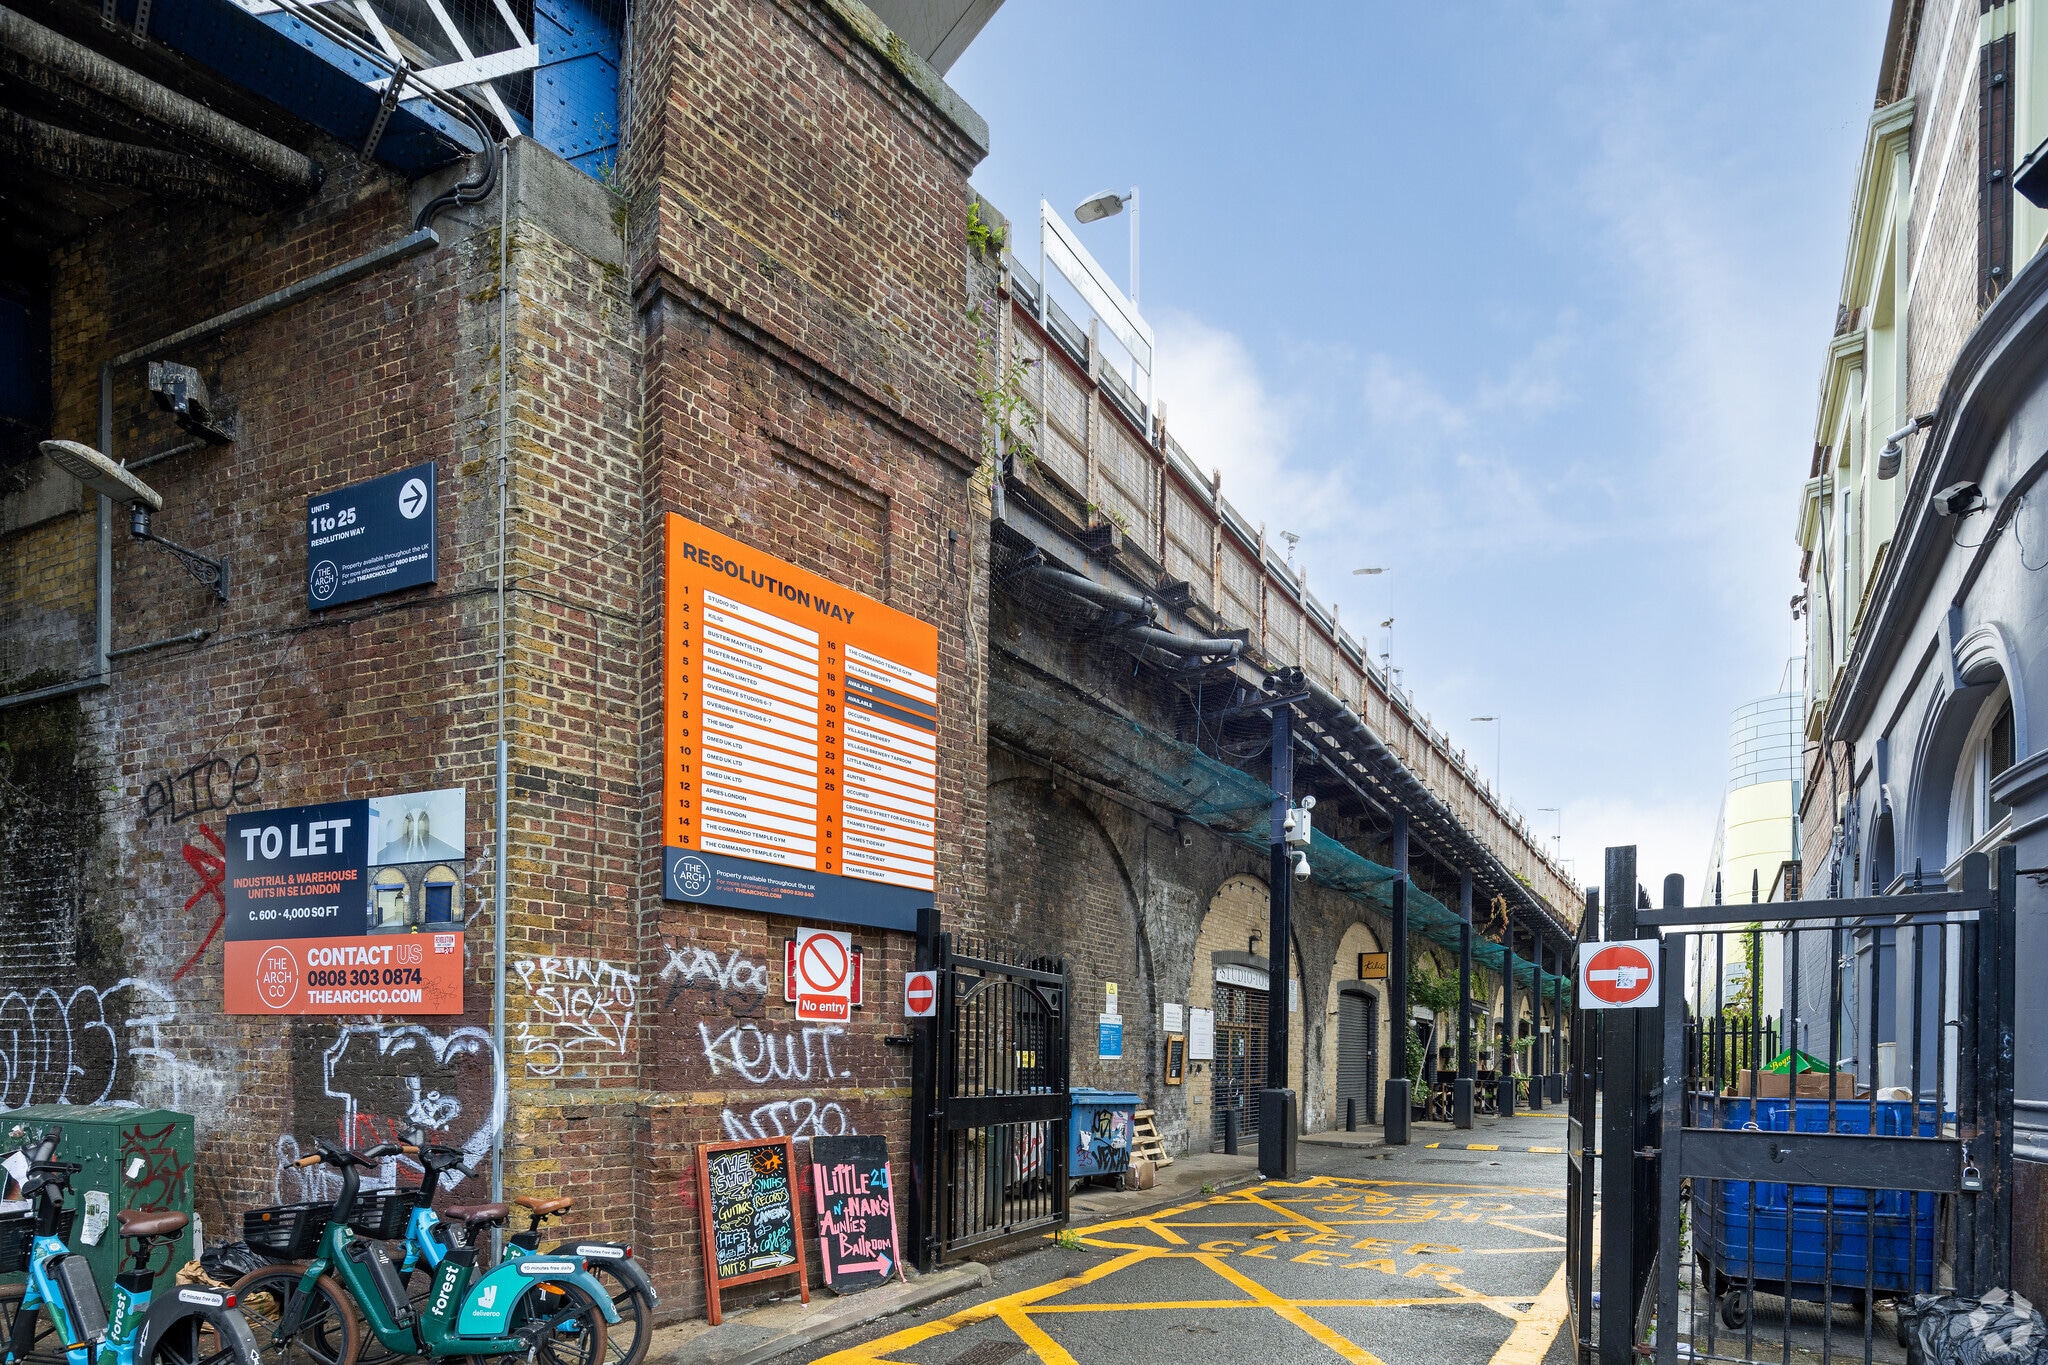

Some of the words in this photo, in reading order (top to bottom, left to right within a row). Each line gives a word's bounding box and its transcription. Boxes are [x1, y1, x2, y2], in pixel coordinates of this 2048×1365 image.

[311, 503, 330, 513] UNITS
[311, 518, 317, 534] 1
[321, 517, 335, 532] to
[338, 507, 356, 528] 25
[311, 531, 349, 547] RESOLUTION
[350, 527, 365, 538] WAY
[342, 560, 362, 570] Property
[363, 555, 383, 565] available
[384, 548, 411, 561] throughout
[315, 575, 334, 586] ARCH
[318, 567, 331, 577] THE
[357, 568, 397, 582] THEARCHCO.COM
[319, 585, 329, 594] CO
[683, 542, 811, 608] RESOLUTION
[814, 595, 855, 625] WAY
[684, 586, 689, 594] 1
[708, 595, 729, 607] STUDIO
[683, 604, 689, 612] 2
[708, 613, 723, 622] KILIG
[683, 622, 689, 630] 3
[708, 630, 730, 642] BUSTER
[730, 638, 752, 650] MANTIS
[683, 657, 689, 665] 5
[707, 665, 734, 679] HARLANS
[735, 674, 757, 686] LIMITED
[827, 673, 836, 681] 18
[682, 675, 689, 683] 6
[707, 683, 739, 697] OVERDRIVE
[739, 692, 763, 704] STUDIOS
[682, 710, 688, 719] 8
[826, 704, 836, 713] 20
[848, 711, 870, 722] OCCUPIED
[706, 736, 723, 744] OMED
[826, 720, 834, 728] 21
[847, 727, 869, 737] VILLAGES
[870, 733, 890, 743] BREWERY
[825, 751, 835, 760] 23
[847, 757, 862, 766] LITTLE
[826, 736, 835, 744] 22
[847, 742, 869, 752] VILLAGES
[869, 749, 890, 759] BREWERY
[891, 756, 912, 765] TAPROOM
[825, 767, 835, 775] 24
[847, 773, 866, 782] AUNTIES
[680, 782, 690, 790] 12
[724, 791, 747, 801] LONDON
[846, 804, 873, 815] CROSSFIELD
[899, 816, 916, 825] ACCESS
[847, 820, 865, 828] THAMES
[866, 824, 885, 832] TIDEWAY
[240, 826, 283, 861] TO
[290, 818, 351, 858] LET
[679, 835, 689, 843] 15
[718, 843, 750, 853] COMMANDO
[751, 849, 773, 858] TEMPLE
[680, 871, 705, 882] ARCH
[684, 863, 701, 873] THE
[234, 875, 286, 888] INDUSTRIAL
[288, 874, 295, 884] &
[296, 869, 357, 884] WAREHOUSE
[685, 880, 700, 890] CO
[717, 870, 742, 879] Property
[743, 874, 767, 883] available
[767, 877, 797, 888] throughout
[248, 888, 275, 899] UNITS
[276, 887, 286, 896] IN
[287, 887, 299, 896] SE
[300, 883, 340, 895] LONDON
[249, 911, 258, 921] C.
[259, 909, 277, 920] 600
[283, 907, 310, 920] 4,000
[312, 907, 325, 918] SQ
[326, 906, 339, 916] FT
[268, 958, 287, 970] THE
[307, 946, 394, 966] CONTACT
[396, 944, 422, 965] US
[263, 972, 291, 984] ARCH
[307, 970, 347, 986] 0808
[350, 969, 379, 986] 303
[382, 968, 422, 985] 0874
[1221, 966, 1252, 984] STUDIO
[269, 985, 285, 997] CO
[308, 989, 422, 1003] THEARCHCO.COM
[801, 1000, 816, 1011] No
[820, 1002, 845, 1015] entry
[1770, 1056, 1791, 1070] Boyn
[713, 1152, 749, 1173] THE
[717, 1168, 755, 1193] SHOP
[754, 1177, 783, 1192] SYNTHS
[755, 1190, 788, 1207] RECORDS
[719, 1201, 754, 1221] GUITARS
[754, 1206, 791, 1223] CAMERAS
[1255, 1229, 1464, 1255] KEEP
[720, 1262, 738, 1277] UNIT
[740, 1261, 746, 1271] 8
[1198, 1240, 1474, 1291] CLEAR
[432, 1266, 459, 1316] forest
[111, 1293, 126, 1341] forest
